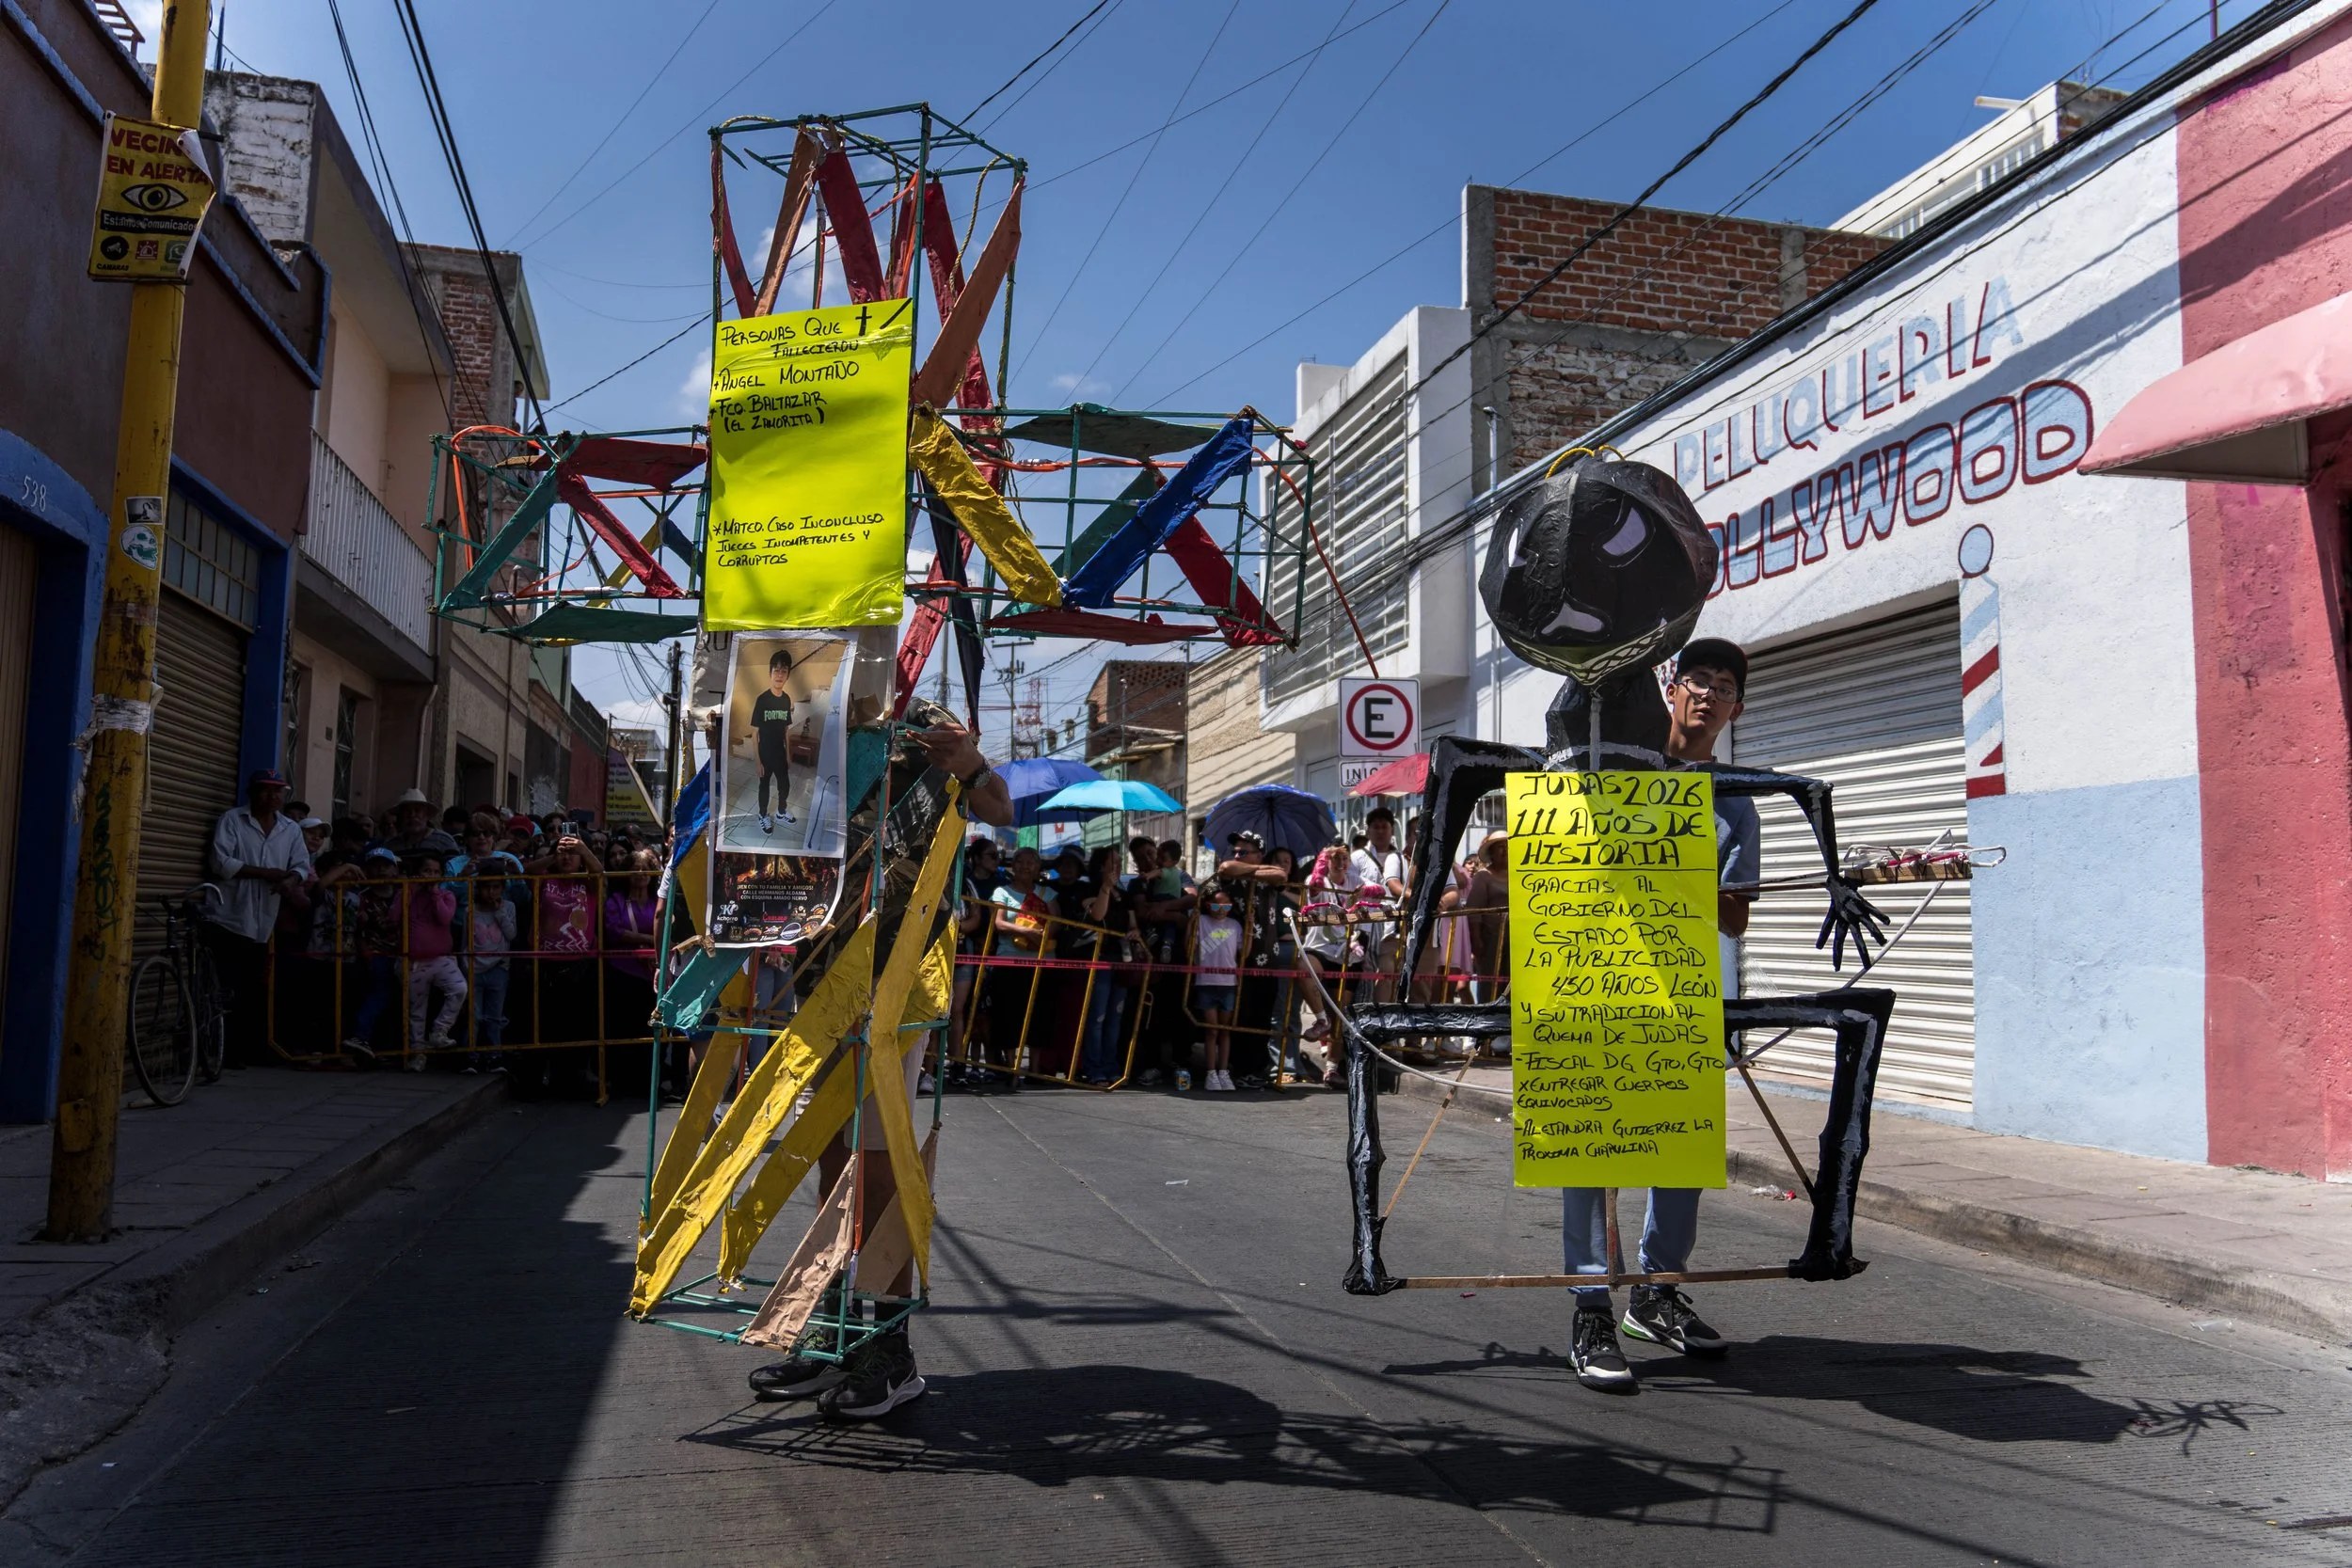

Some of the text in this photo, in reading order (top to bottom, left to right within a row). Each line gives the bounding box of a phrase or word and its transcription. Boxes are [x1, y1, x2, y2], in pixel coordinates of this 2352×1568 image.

[111, 128, 191, 157] VECIN
[107, 154, 210, 185] EN ALERTA
[722, 325, 796, 347] PERSONAS
[771, 340, 860, 357] FALLECIERON
[780, 360, 859, 384] MONTAÑO
[1674, 276, 2024, 491] PELUQUERIA
[747, 390, 827, 413] BALTAZAR
[22, 474, 46, 513] 538
[768, 516, 794, 532] CASO
[716, 530, 870, 553] JUECES INCOMPETENTES Y
[718, 553, 788, 567] CORRUPTOS
[764, 709, 787, 721] FORTNITE
[1364, 698, 1394, 738] E
[1519, 773, 1703, 807] JUDAS 2026
[1565, 808, 1658, 836] AÑOS
[1664, 811, 1707, 837] DE
[1520, 839, 1680, 867] HISTORIA
[1521, 874, 1661, 894] GRACIAS AL
[1528, 894, 1702, 919] GOBIERNO DEL
[1534, 922, 1686, 945] ESTADO POR
[540, 940, 590, 952] REECE
[1524, 944, 1706, 968] LA PUBLICIDAD
[1551, 975, 1594, 996] 450
[1601, 971, 1659, 998] AÑOS
[1520, 1002, 1532, 1023] Y
[1534, 1023, 1708, 1046] QUEMA DE JUDAS
[1614, 1076, 1689, 1092] CUERPOS
[1517, 1095, 1613, 1111] EQUIVOCADOS
[1613, 1119, 1688, 1137] GUTIERREZ
[1694, 1119, 1714, 1132] LA
[1518, 1142, 1579, 1161] PROXIMA
